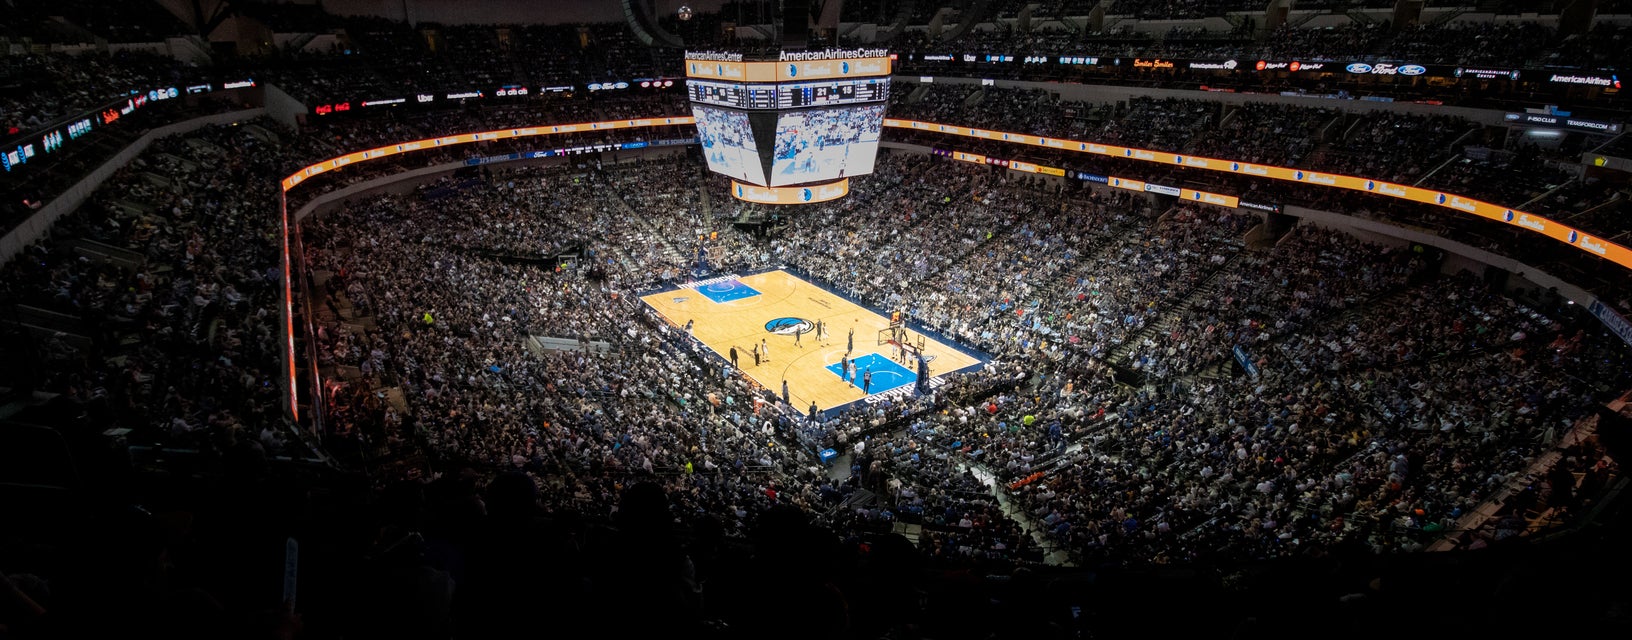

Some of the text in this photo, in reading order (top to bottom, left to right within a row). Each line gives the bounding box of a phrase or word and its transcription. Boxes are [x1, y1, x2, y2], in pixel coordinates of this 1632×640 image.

[963, 54, 976, 62] Uber
[1371, 63, 1398, 75] Ford
[817, 88, 827, 96] 21
[842, 86, 852, 95] 15
